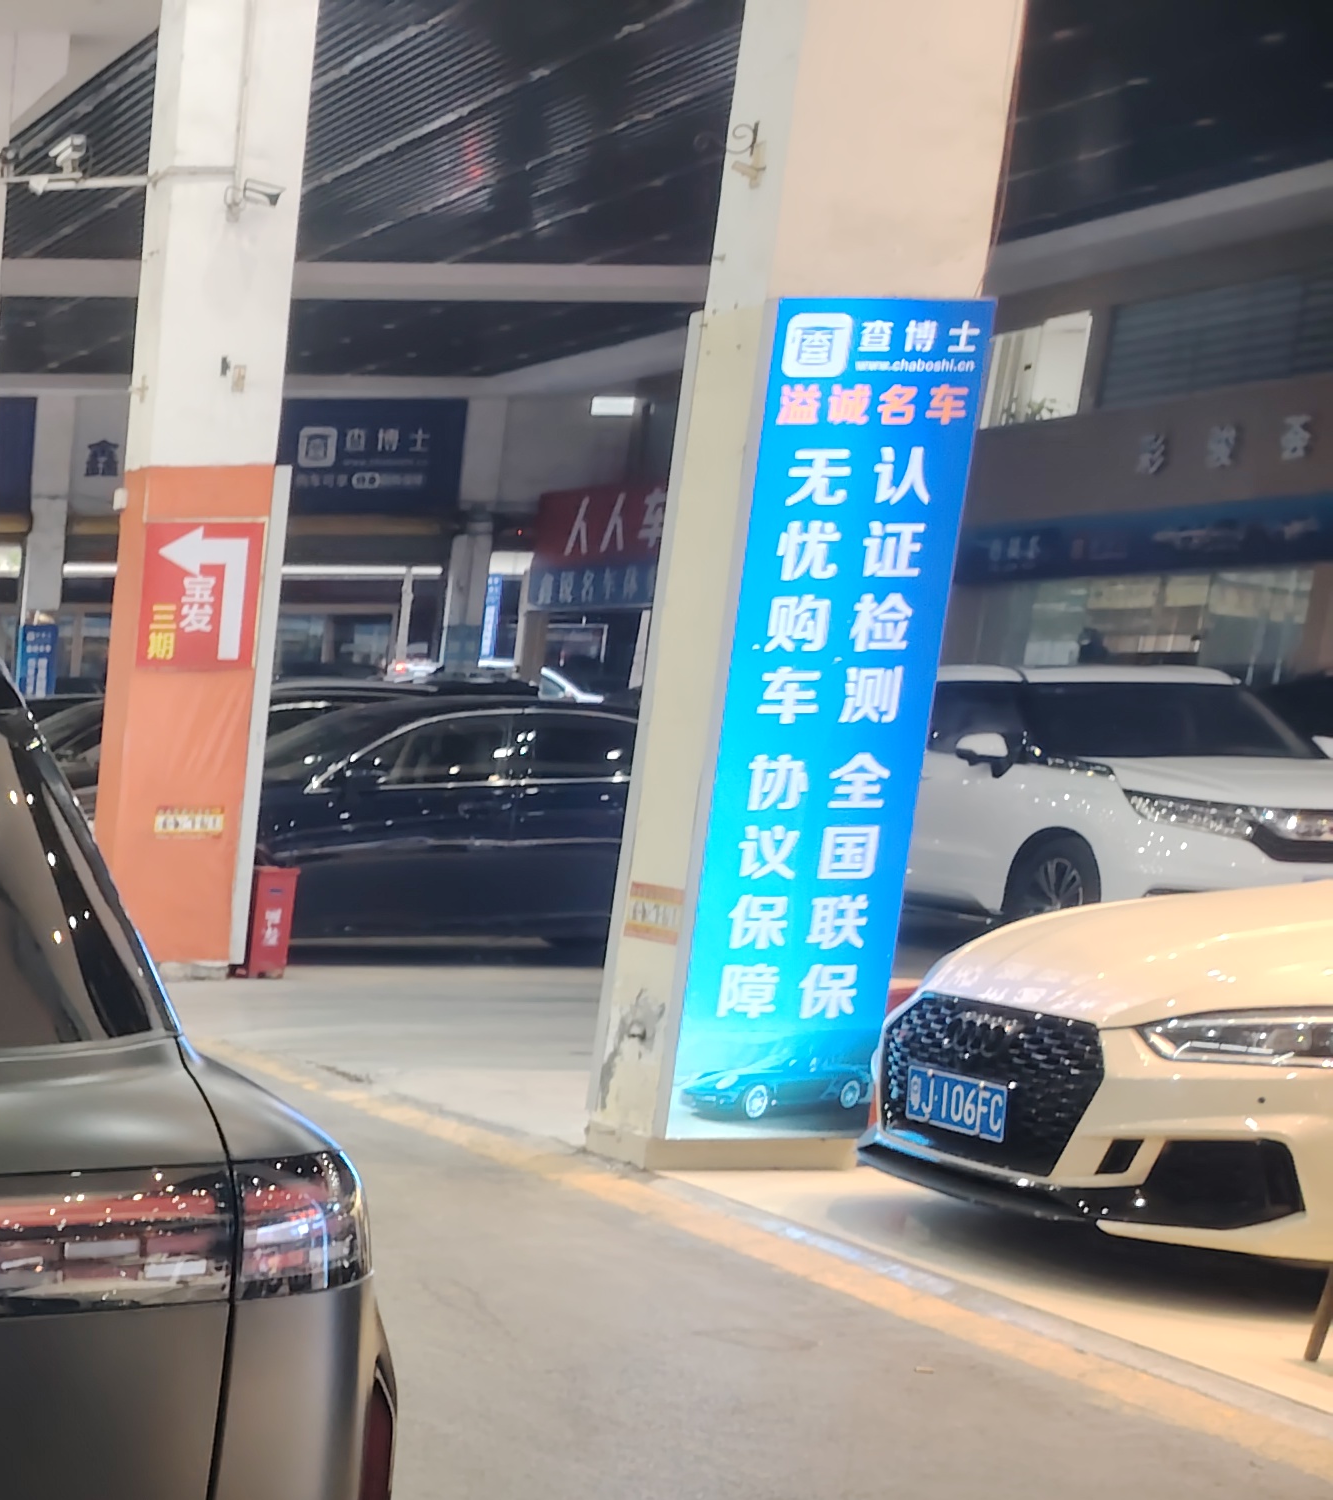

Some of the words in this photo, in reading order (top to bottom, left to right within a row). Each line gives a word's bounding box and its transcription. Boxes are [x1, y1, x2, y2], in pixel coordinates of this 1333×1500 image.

[855, 358, 976, 373] www.chaboshi.cn
[857, 319, 981, 353] 查博士
[776, 383, 969, 426] 溢诚名车
[179, 574, 216, 633] 宝发
[757, 448, 852, 724] 无忧购车
[838, 446, 931, 723] 认证检测
[147, 604, 177, 660] 三期
[717, 754, 809, 1019] 协议保障
[799, 752, 890, 1019] 全国联保
